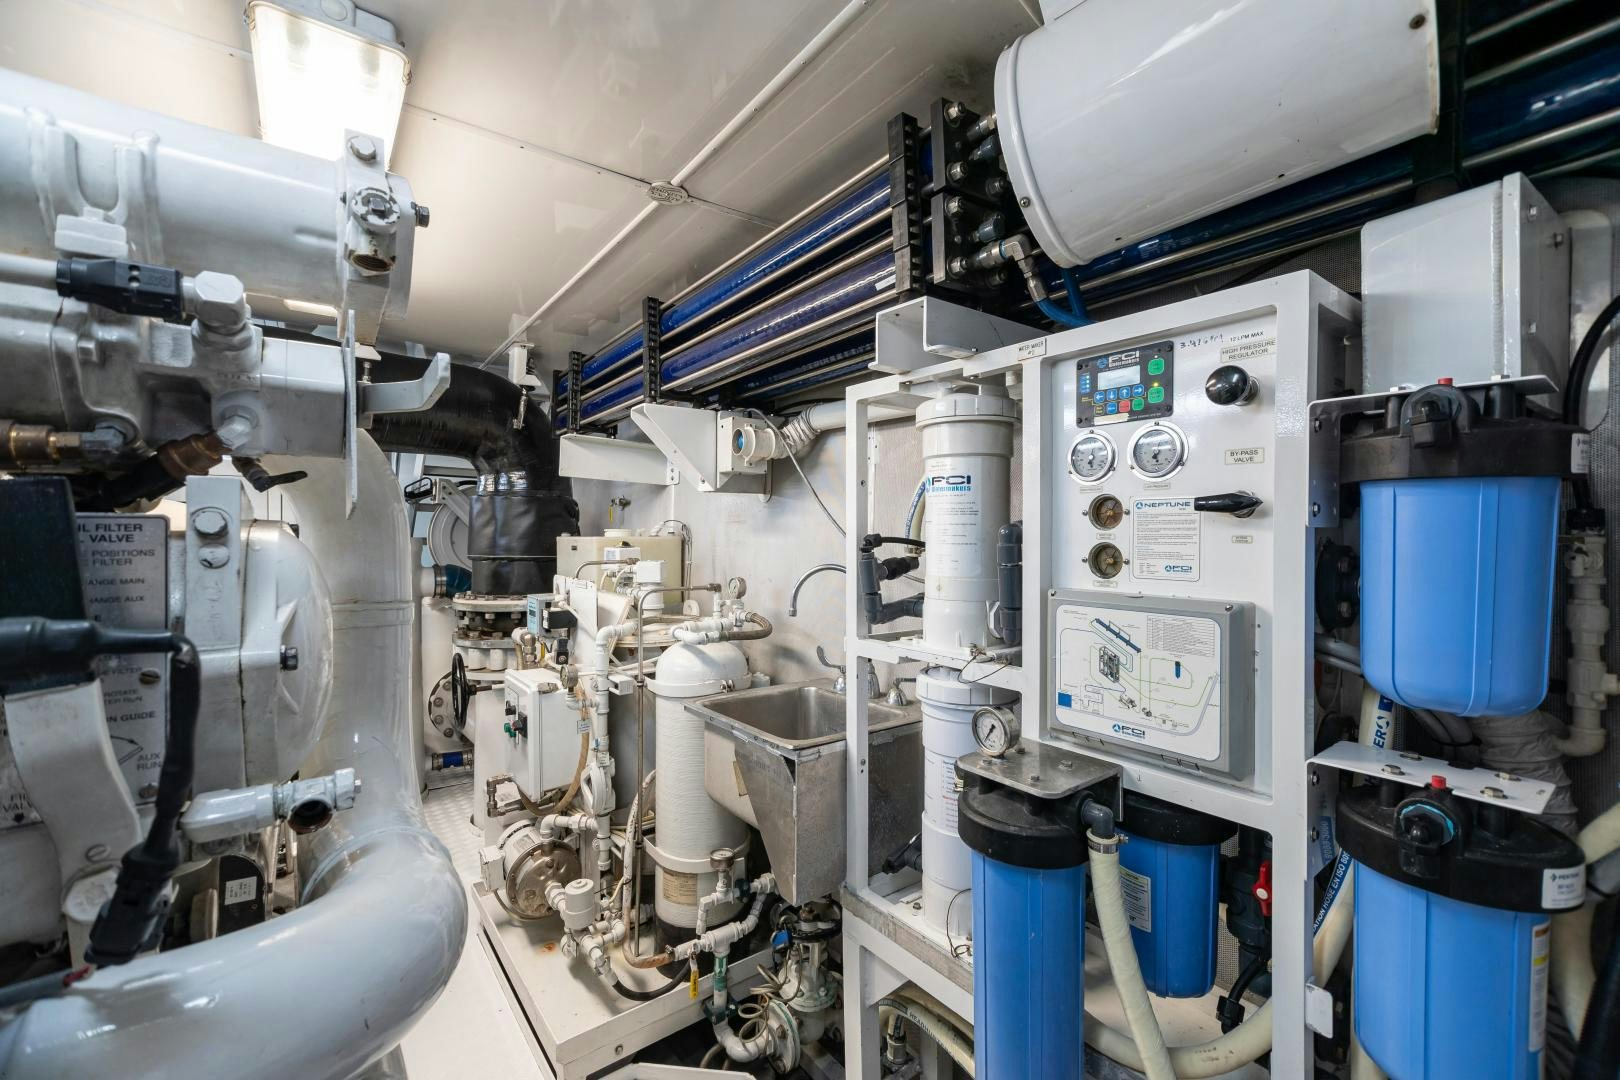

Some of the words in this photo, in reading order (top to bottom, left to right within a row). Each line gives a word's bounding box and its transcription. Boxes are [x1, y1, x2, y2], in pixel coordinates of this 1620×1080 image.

[1222, 347, 1239, 355] HIGH
[1240, 339, 1276, 352] PRESSURE
[1108, 350, 1140, 364] FCI
[1228, 348, 1269, 360] REGULATOR
[1230, 449, 1259, 457] BY-PASS
[931, 475, 972, 486] FCI
[78, 523, 91, 532] IL
[95, 523, 143, 532] FILTER
[89, 534, 135, 543] VALVE
[91, 549, 156, 558] POSITIONS
[92, 558, 133, 566] FILTER
[88, 578, 117, 586] ANGE
[119, 577, 145, 585] MAIN
[121, 710, 156, 722] GUIDE
[137, 752, 161, 761] AUX
[137, 761, 161, 771] RUN
[1335, 863, 1346, 879] ISO
[1331, 874, 1341, 890] EN
[1323, 887, 1335, 912] HOSE
[1313, 907, 1326, 932] ATION
